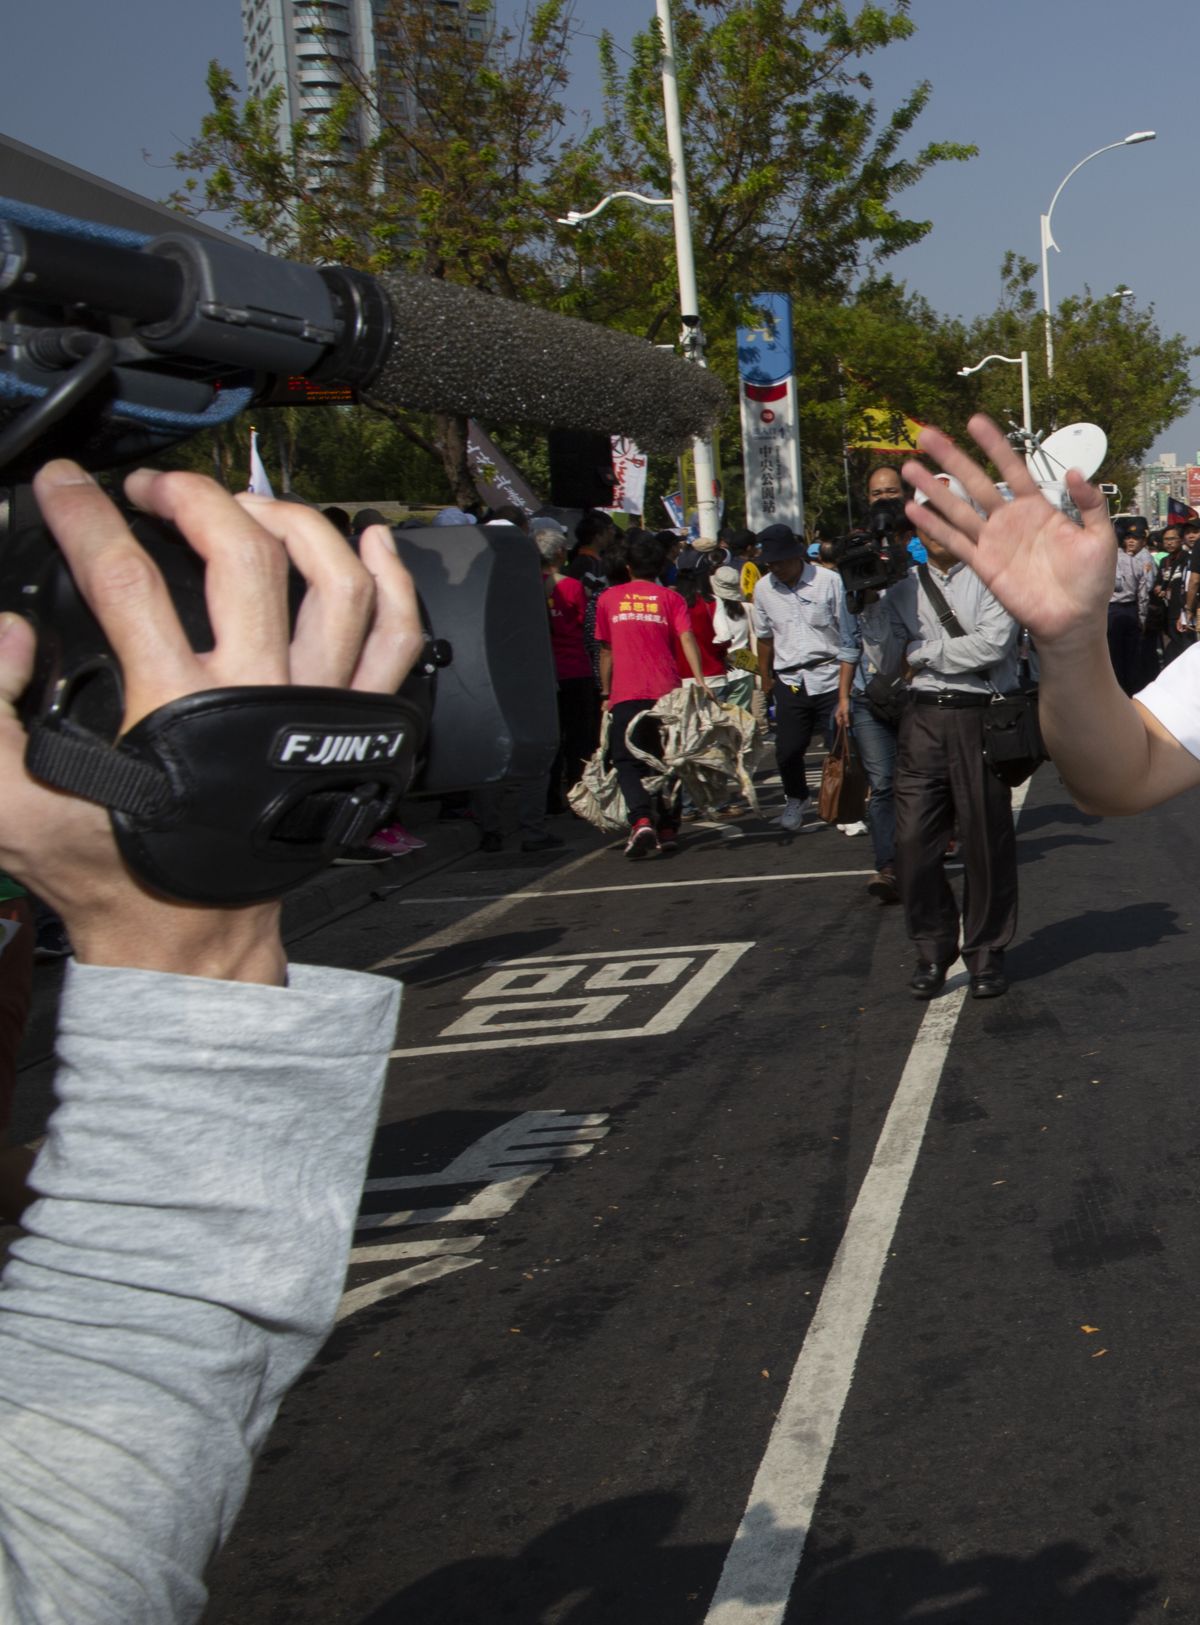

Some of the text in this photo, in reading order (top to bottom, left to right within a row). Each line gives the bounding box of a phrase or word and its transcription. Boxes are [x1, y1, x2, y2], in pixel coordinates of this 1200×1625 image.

[759, 446, 776, 514] 中央公園站
